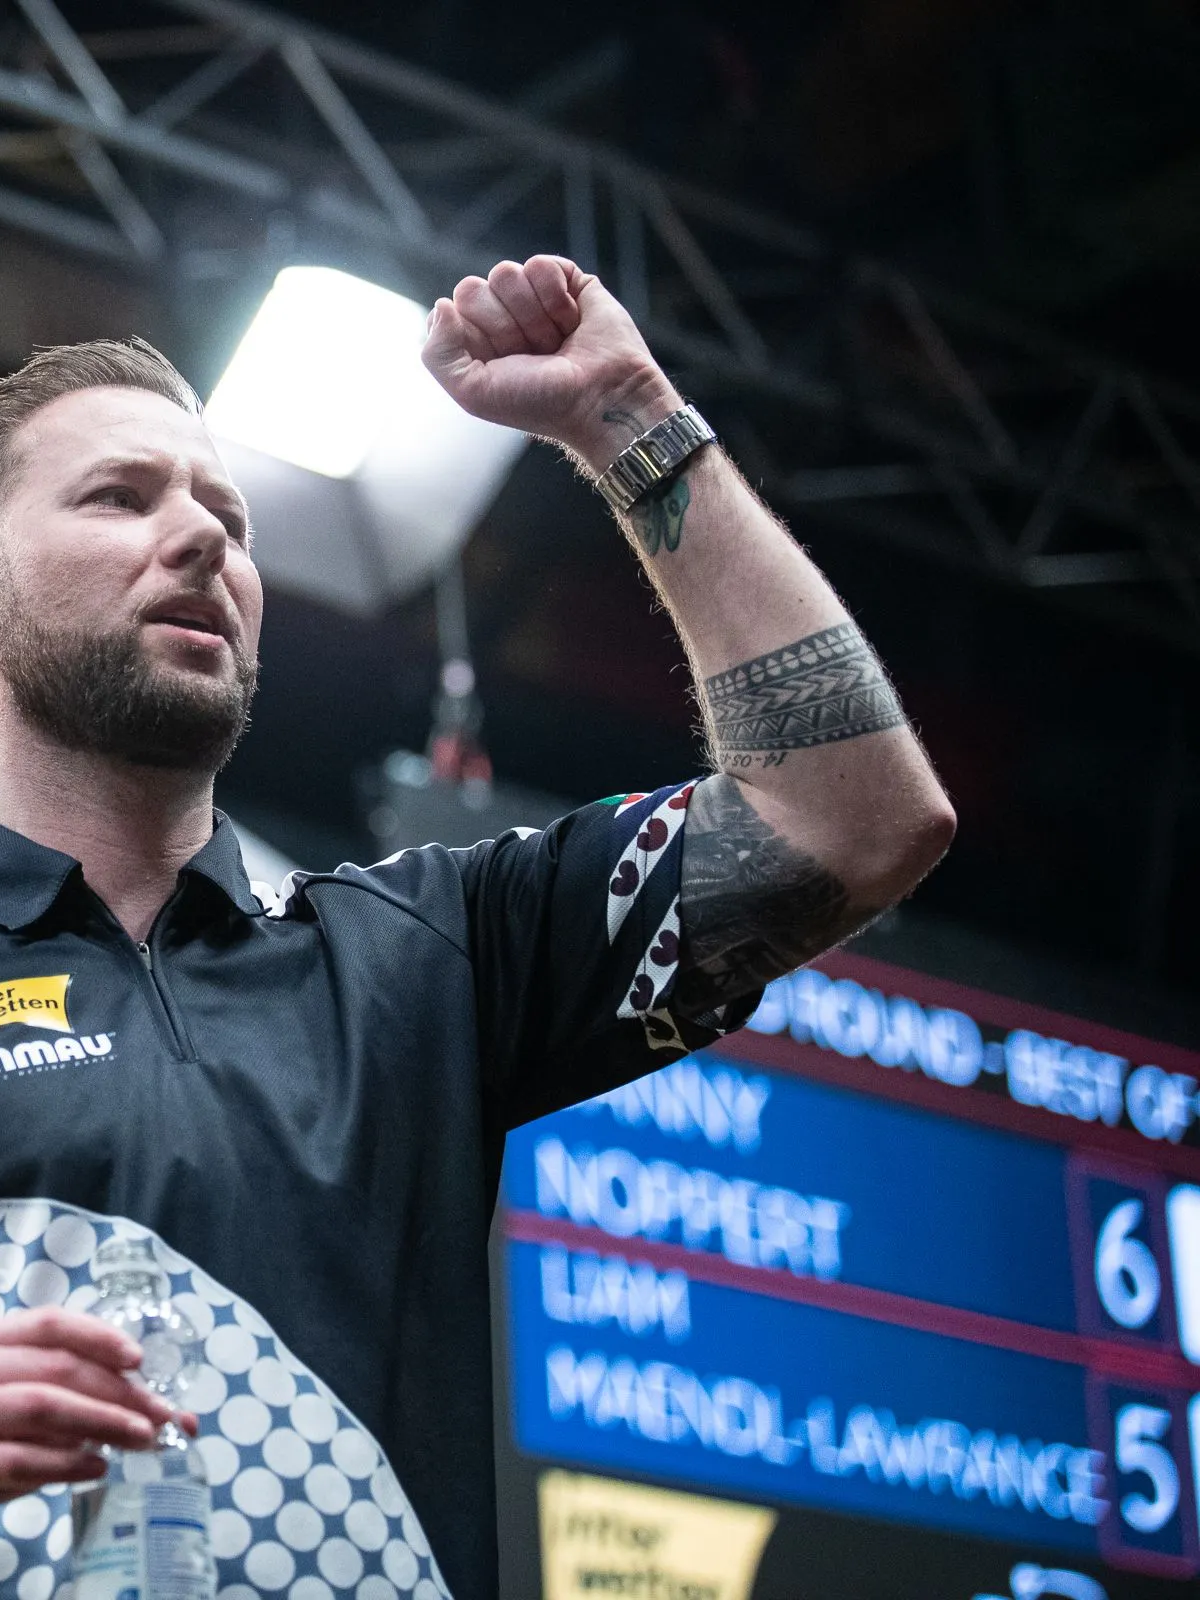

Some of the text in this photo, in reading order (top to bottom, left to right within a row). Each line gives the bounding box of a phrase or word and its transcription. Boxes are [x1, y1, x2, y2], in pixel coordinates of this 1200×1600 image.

[534, 1136, 848, 1284] NOPPERT
[1094, 1198, 1161, 1329] 6
[540, 1244, 691, 1345] LIAM
[1115, 1403, 1180, 1533] 5
